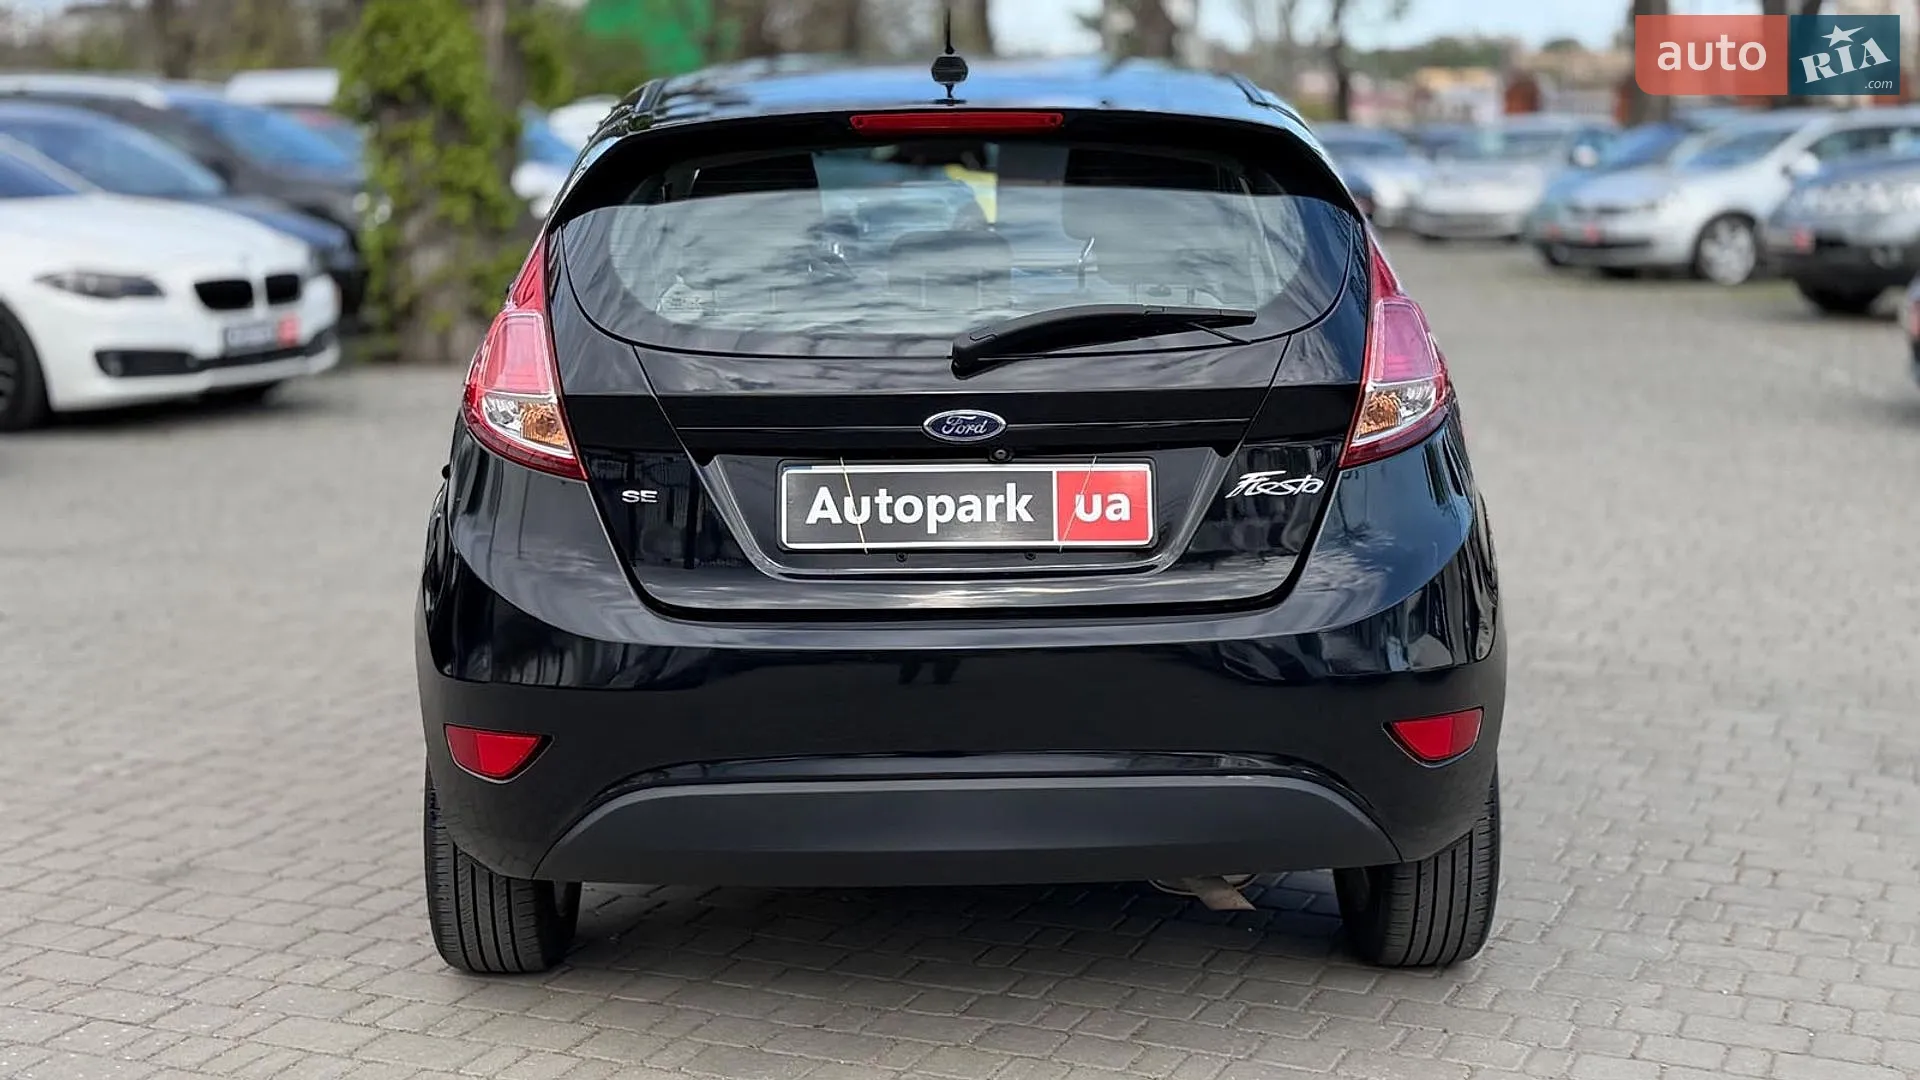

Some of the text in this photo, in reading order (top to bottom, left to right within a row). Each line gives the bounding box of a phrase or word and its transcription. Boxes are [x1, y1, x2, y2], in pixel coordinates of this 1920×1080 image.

[941, 415, 988, 434] Ford
[1225, 470, 1324, 498] Fiesta
[622, 490, 658, 503] SE
[805, 482, 1132, 534] Autopark ua
